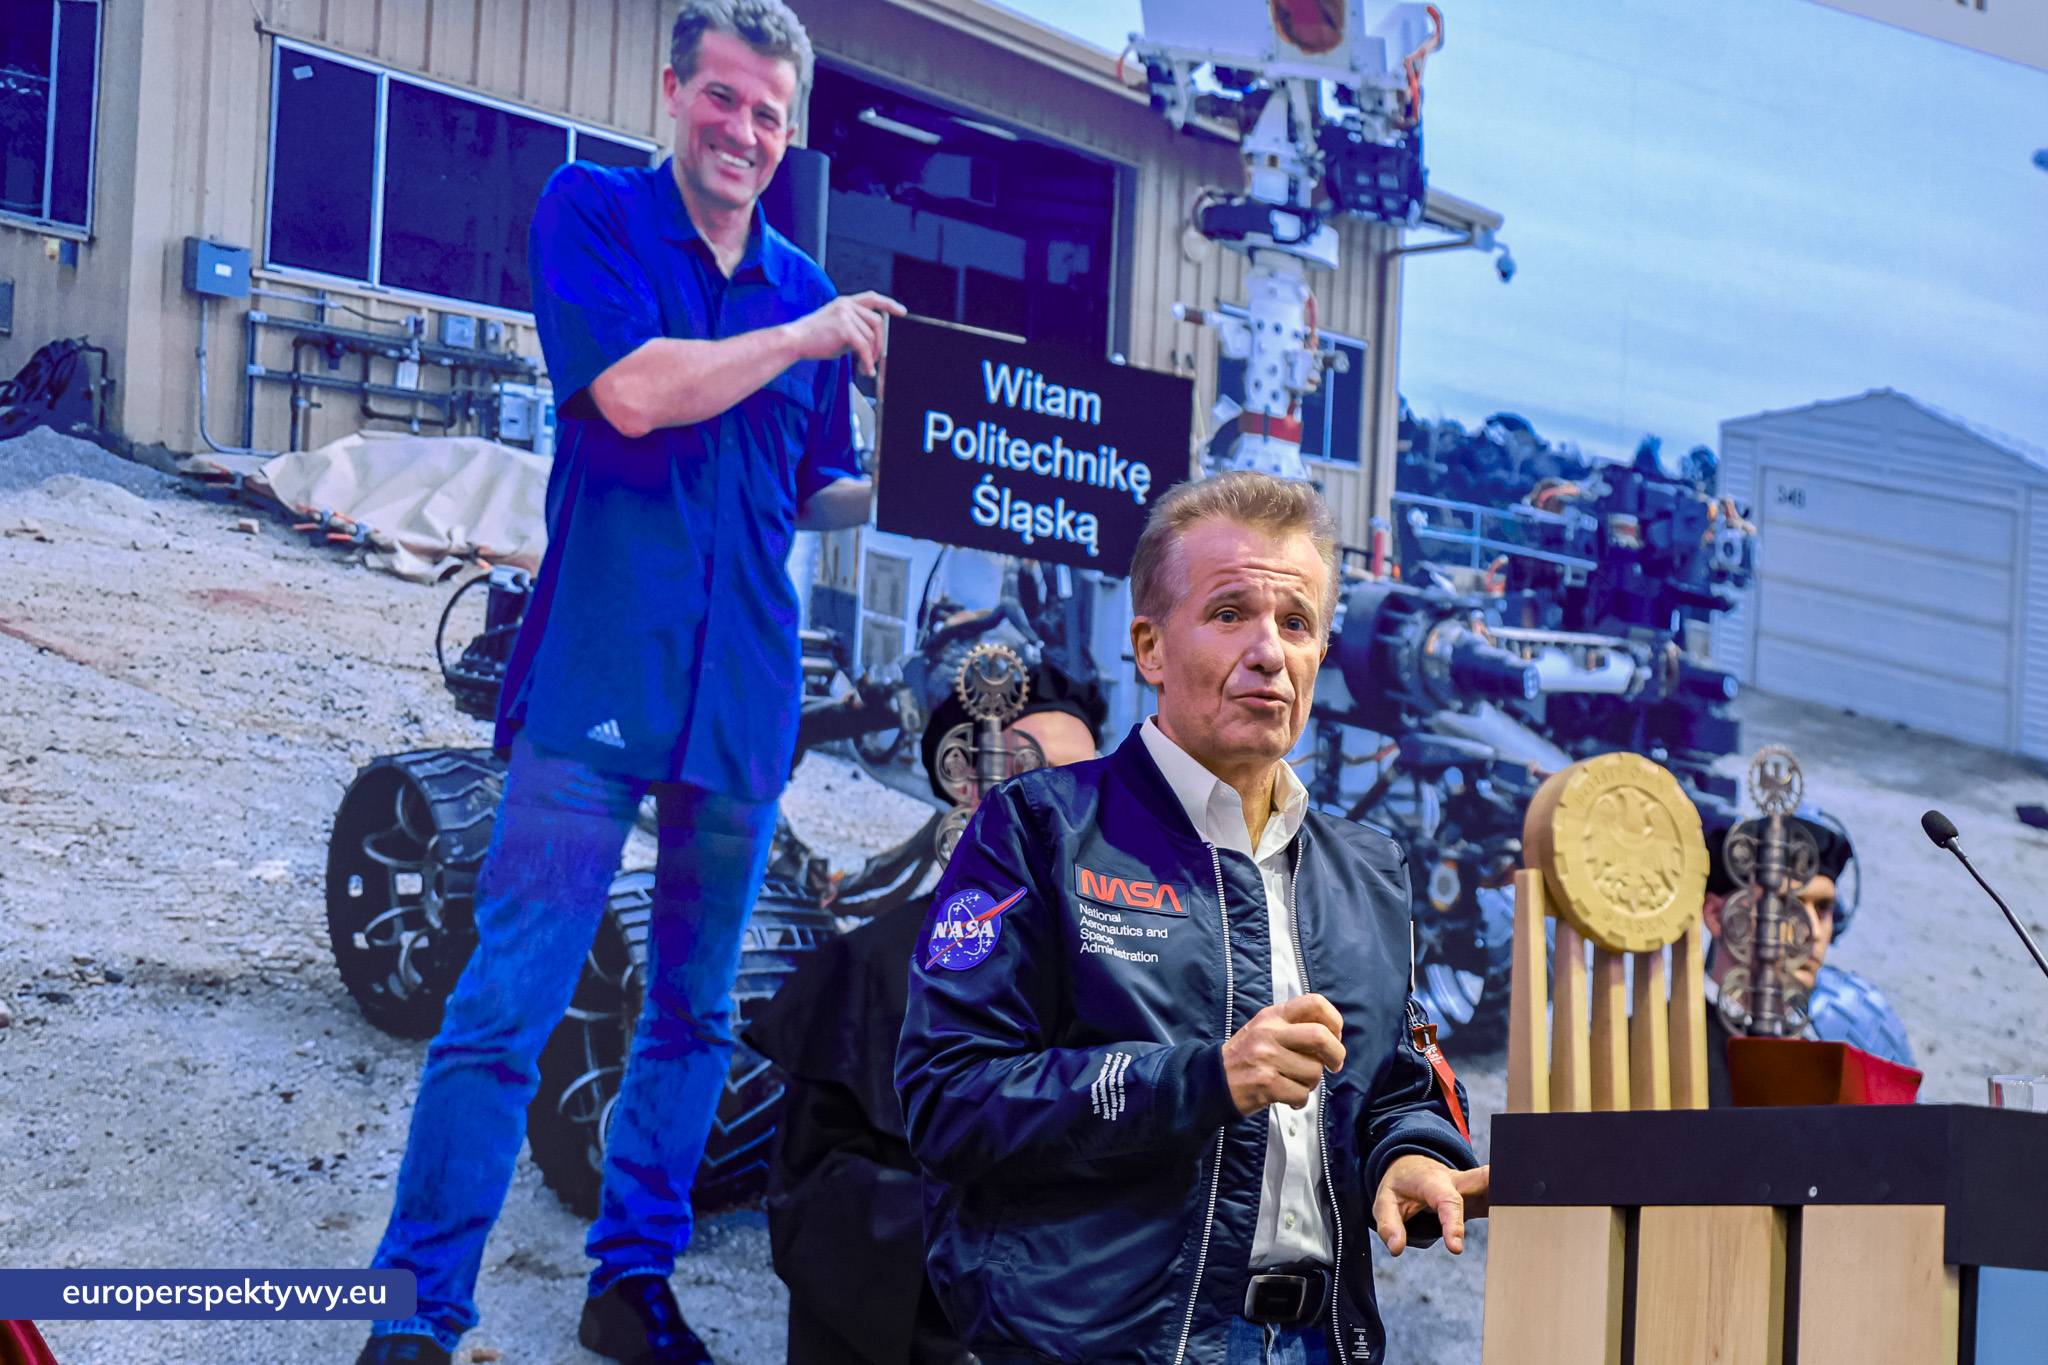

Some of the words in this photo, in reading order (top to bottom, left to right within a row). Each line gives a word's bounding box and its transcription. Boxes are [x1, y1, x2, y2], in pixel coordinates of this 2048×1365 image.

[981, 359, 1102, 425] Witam
[923, 410, 1151, 505] Politechnikę
[970, 473, 1099, 557] Śląską
[1081, 869, 1183, 912] NASA
[1079, 903, 1122, 922] National
[933, 920, 995, 939] NASA
[1080, 916, 1143, 936] Aeronautics
[1146, 928, 1168, 938] and
[1080, 928, 1114, 945] Space
[1080, 941, 1159, 962] Administration
